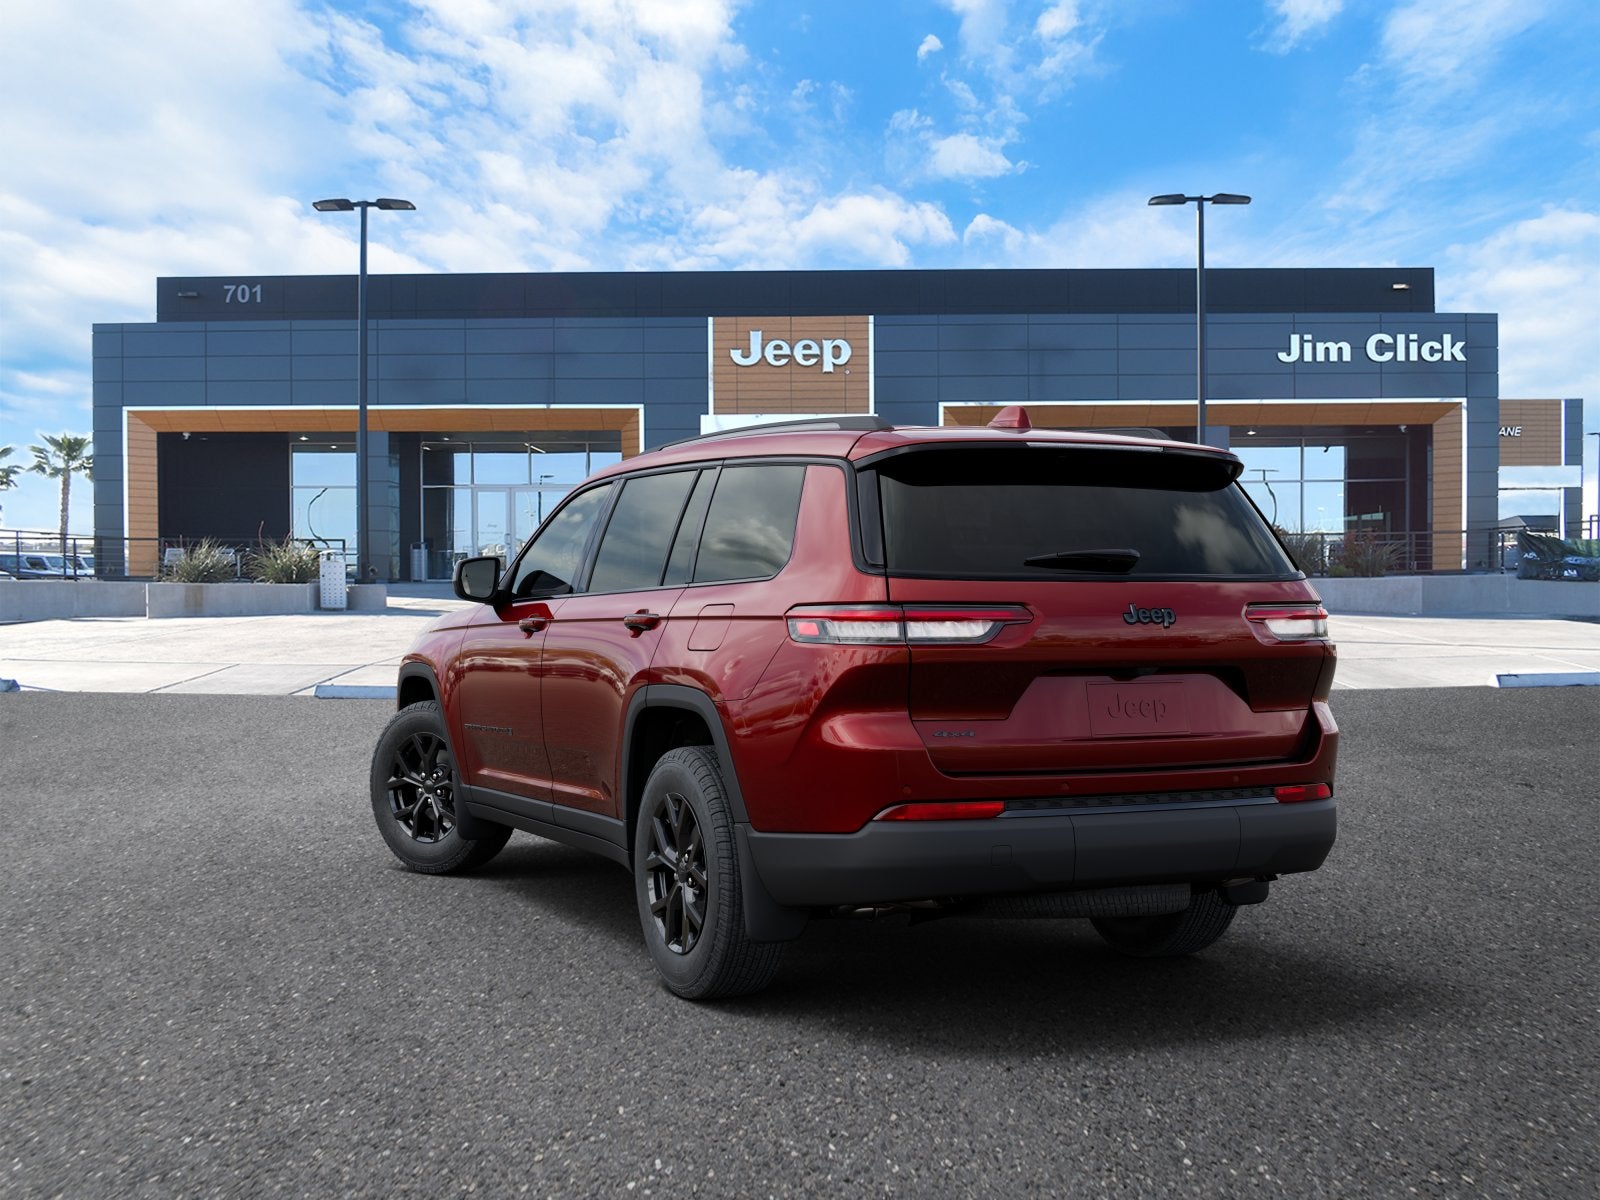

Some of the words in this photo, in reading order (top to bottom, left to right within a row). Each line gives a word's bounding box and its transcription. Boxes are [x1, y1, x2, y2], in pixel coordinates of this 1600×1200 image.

[223, 284, 262, 303] 701
[730, 330, 852, 373] Jeep
[1277, 333, 1351, 362] Jim
[1366, 332, 1467, 362] Click
[1123, 602, 1176, 628] Jeep
[1107, 690, 1166, 723] Jeep
